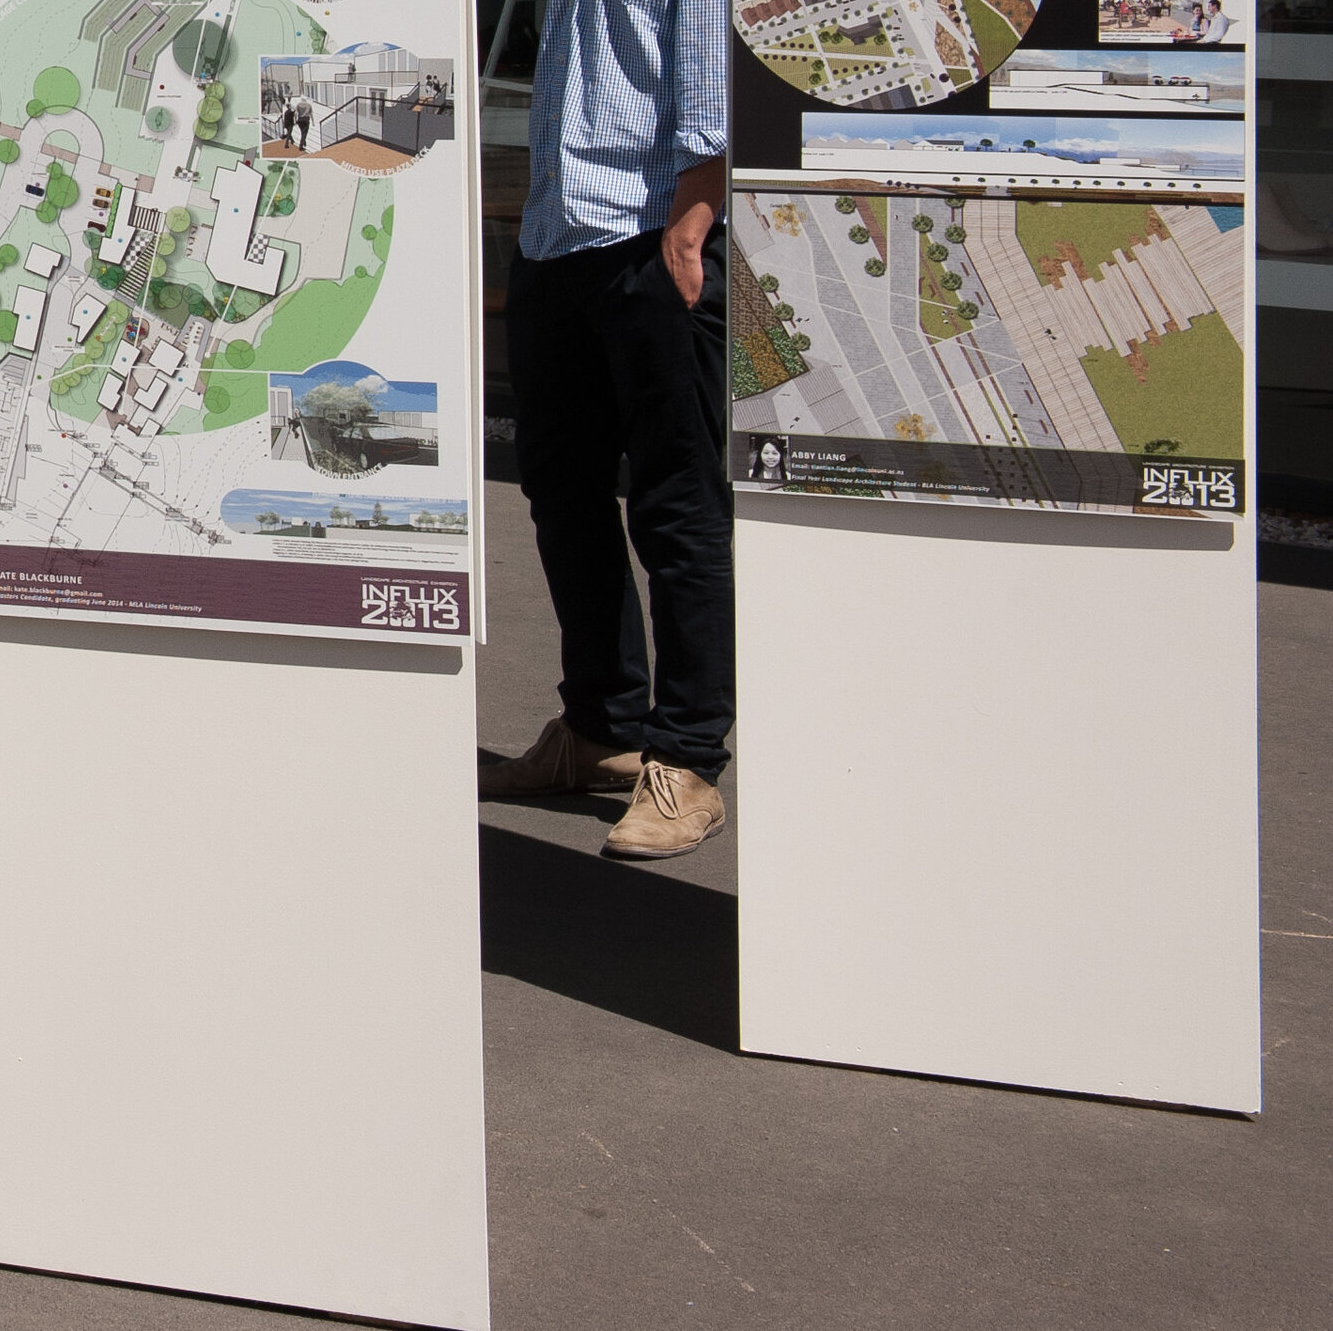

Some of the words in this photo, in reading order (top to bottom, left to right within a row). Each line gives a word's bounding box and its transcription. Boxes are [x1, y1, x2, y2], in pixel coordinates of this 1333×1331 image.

[340, 159, 367, 177] MIXED
[367, 168, 385, 178] USE
[386, 161, 413, 177] PLAZA
[791, 450, 815, 460] ABBY
[817, 452, 847, 462] LIANG
[343, 462, 383, 481] ENTRANCE
[1143, 467, 1235, 487] INFLUX
[821, 476, 853, 484] Landscape
[854, 478, 892, 487] Architecture
[19, 572, 83, 585] BLACKBURNE
[361, 583, 459, 606] INFLUX
[54, 596, 90, 606] graduating
[91, 598, 106, 606] June
[107, 599, 124, 607] 2014
[144, 602, 168, 610] Lincoln
[169, 603, 203, 613] University
